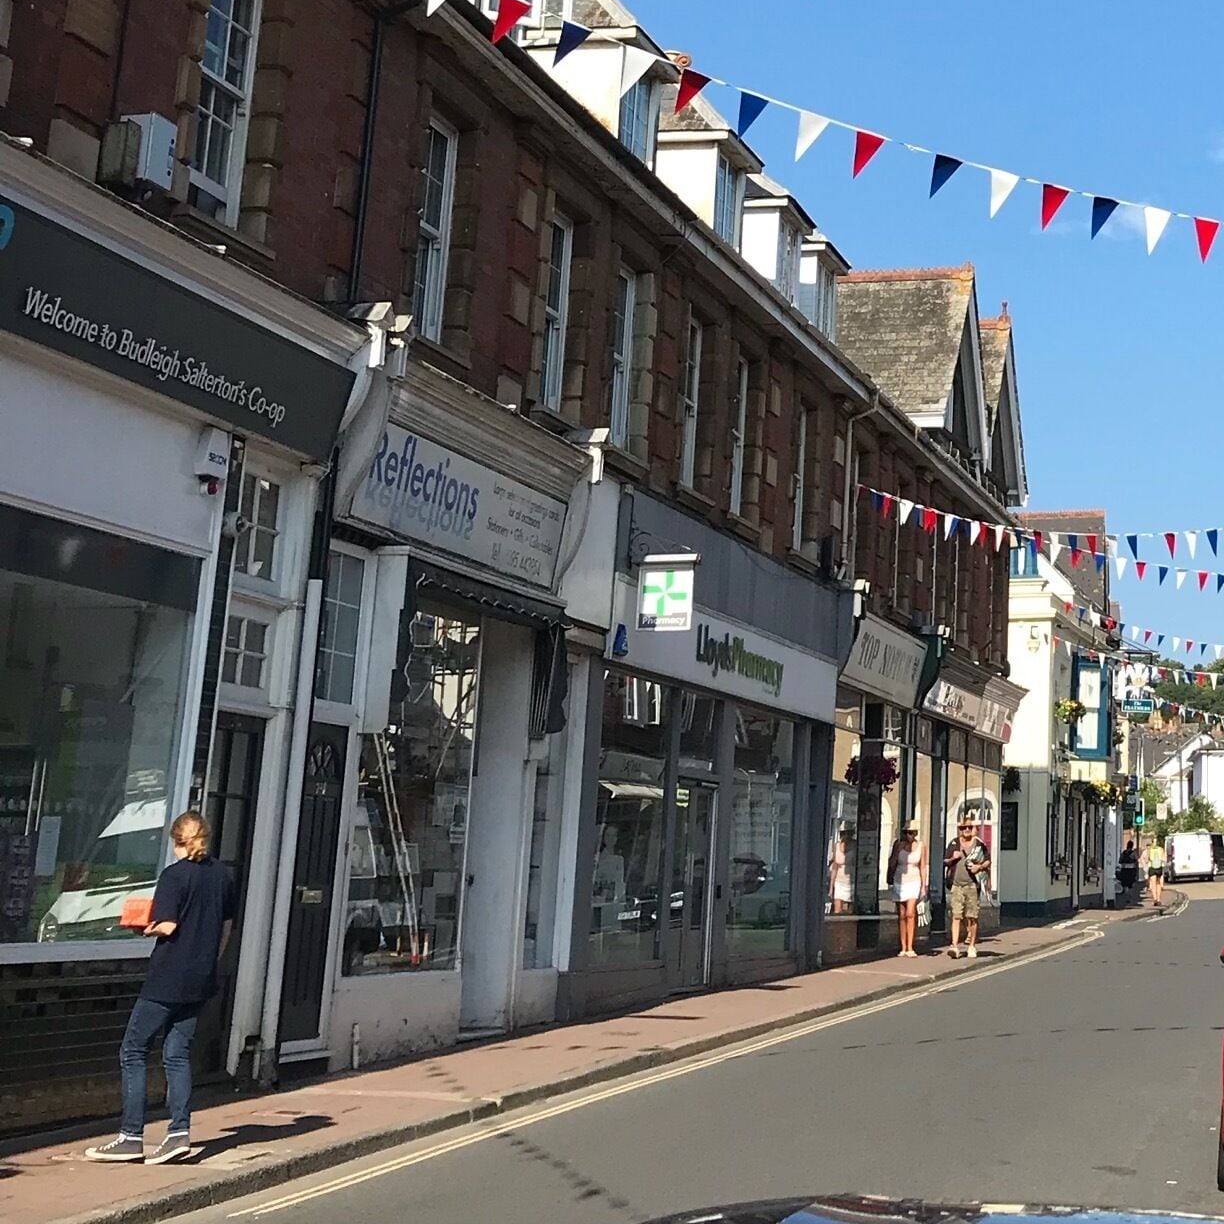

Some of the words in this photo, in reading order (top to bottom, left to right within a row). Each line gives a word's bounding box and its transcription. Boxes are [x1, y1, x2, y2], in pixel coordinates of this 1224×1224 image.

[24, 286, 98, 343] Welcome
[99, 324, 117, 352] to
[117, 328, 180, 380] Budleigh
[181, 357, 247, 406] Salterton's
[248, 386, 286, 428] Co-op
[369, 431, 480, 520] Reflections
[641, 615, 686, 626] Pharmacy
[857, 631, 881, 670] TOP
